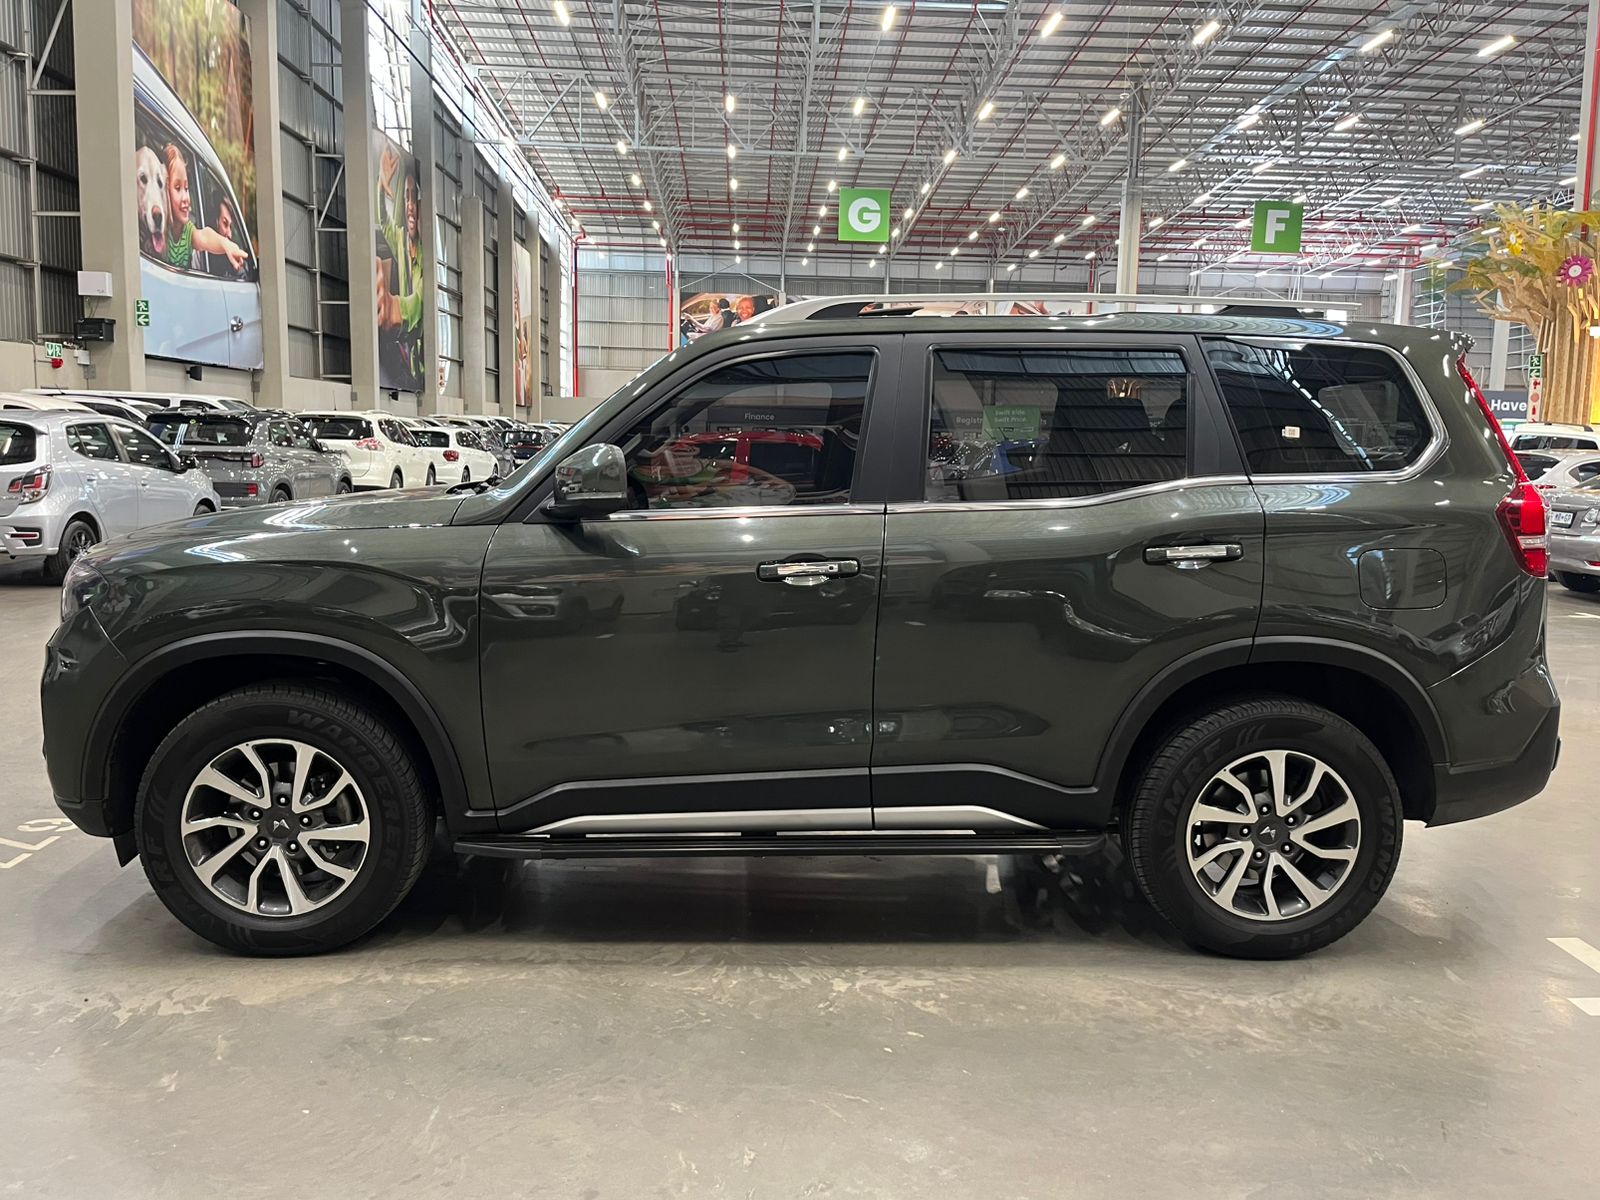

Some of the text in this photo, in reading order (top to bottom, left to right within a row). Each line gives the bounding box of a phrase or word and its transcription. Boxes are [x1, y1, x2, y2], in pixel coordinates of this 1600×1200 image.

[848, 197, 881, 233] G
[1264, 209, 1290, 244] F
[744, 412, 775, 421] Finance
[955, 416, 983, 425] Registr
[1490, 399, 1527, 412] Have
[287, 709, 400, 870] WANDERER
[1168, 739, 1223, 816] MRF
